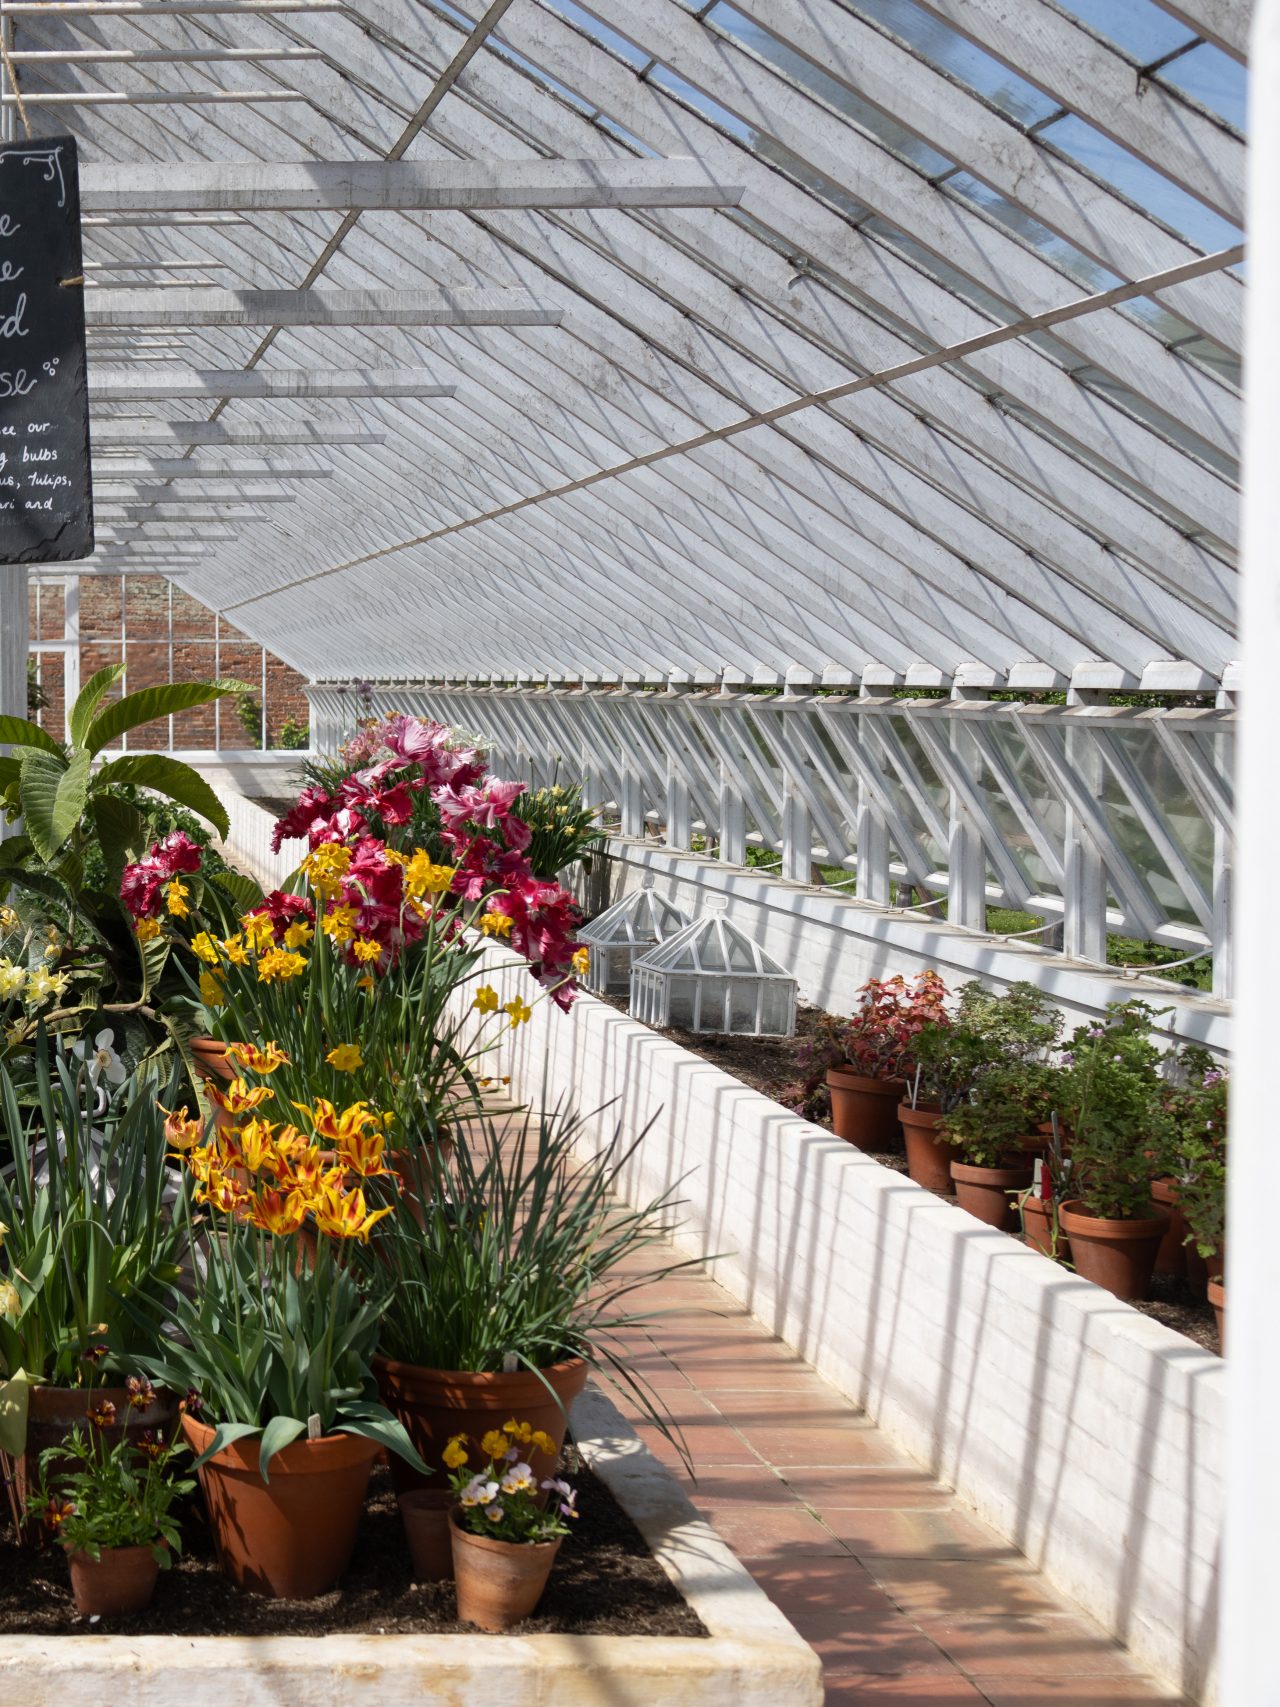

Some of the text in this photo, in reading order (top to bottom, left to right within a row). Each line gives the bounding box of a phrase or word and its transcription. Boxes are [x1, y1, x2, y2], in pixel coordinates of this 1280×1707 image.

[27, 422, 51, 433] our
[22, 445, 58, 462] bulbs
[27, 471, 72, 490] Tulips,
[25, 497, 53, 511] and
